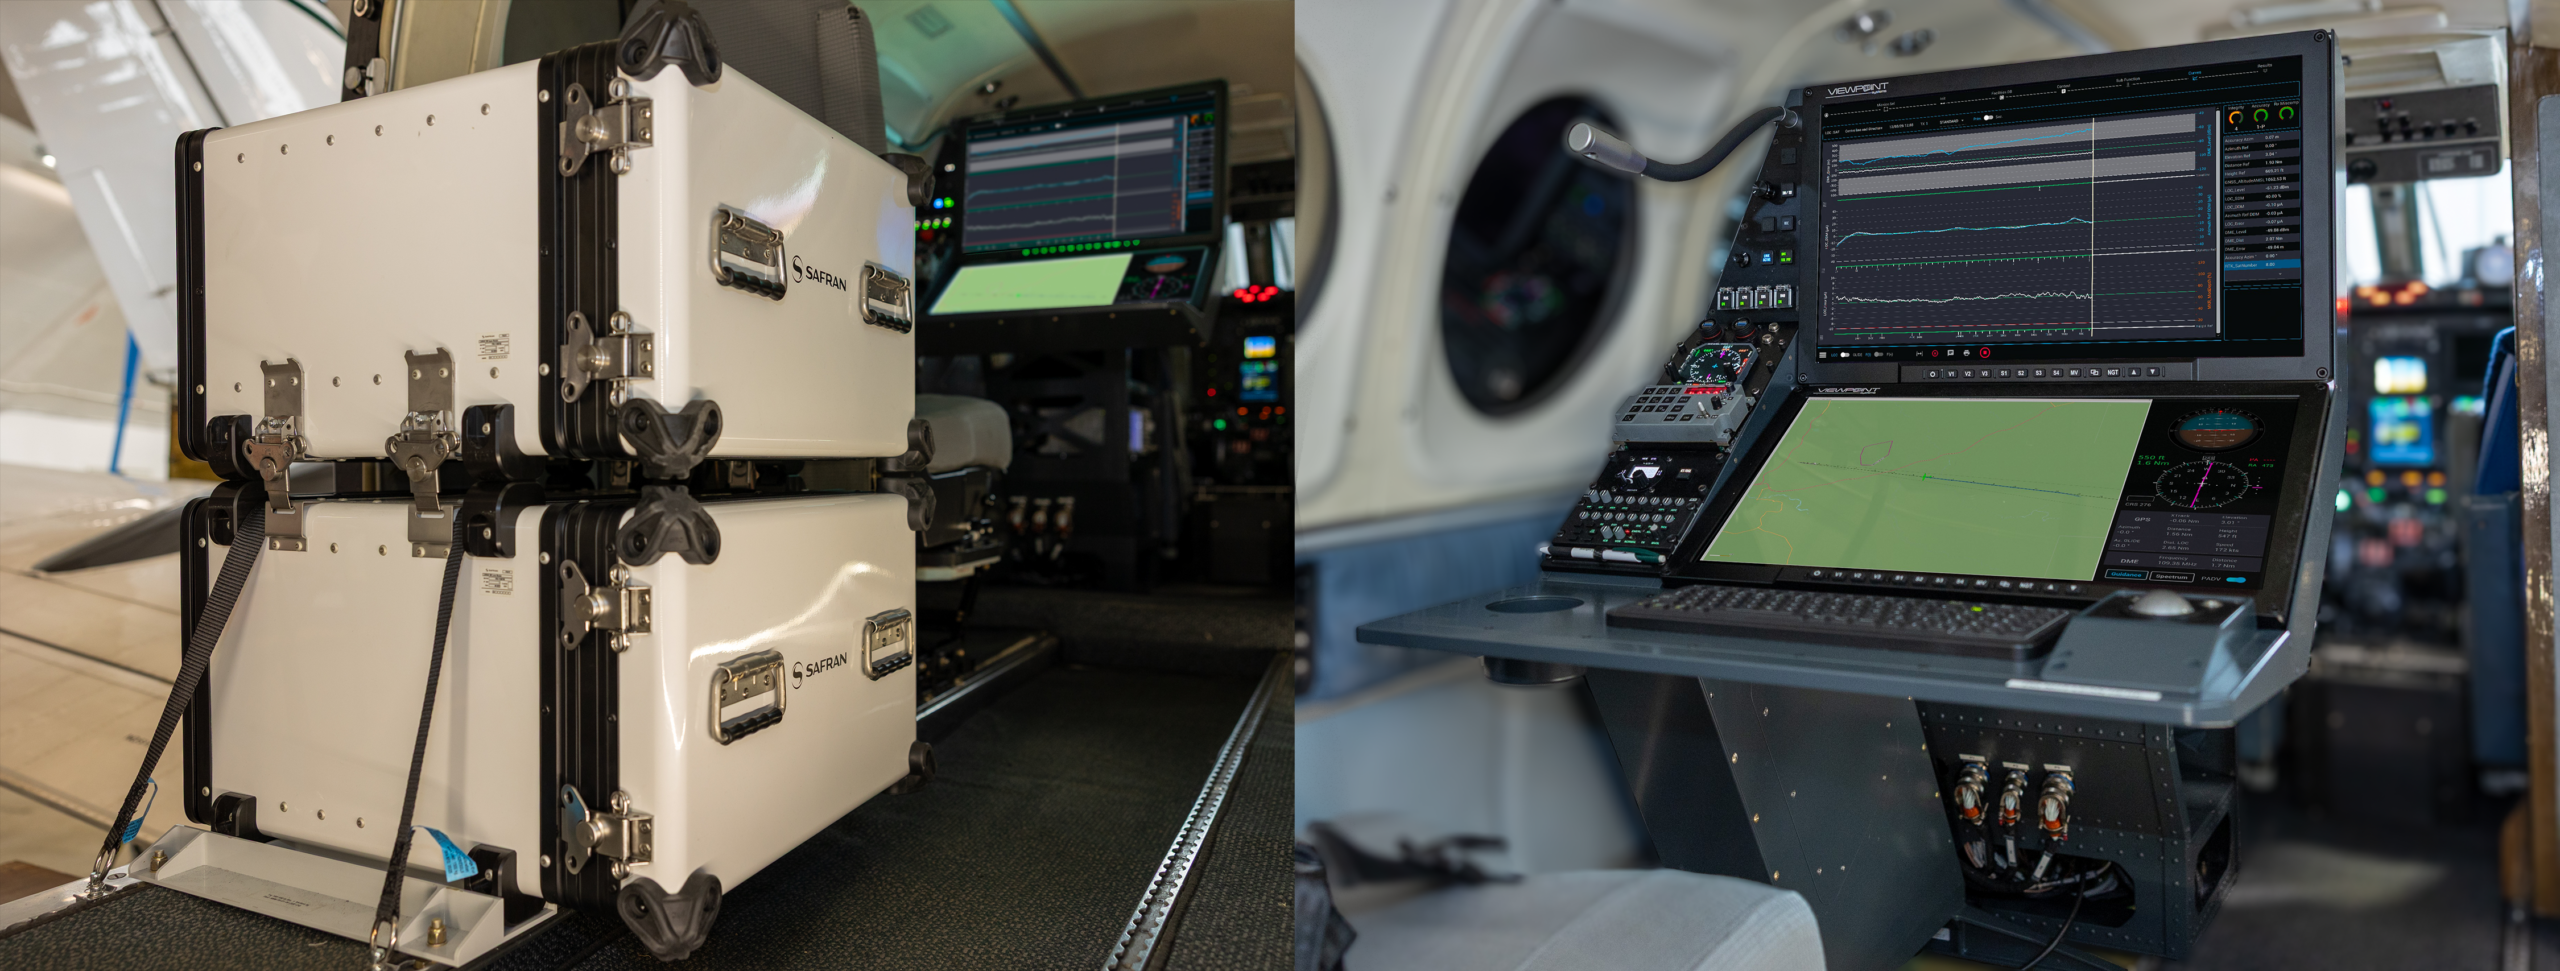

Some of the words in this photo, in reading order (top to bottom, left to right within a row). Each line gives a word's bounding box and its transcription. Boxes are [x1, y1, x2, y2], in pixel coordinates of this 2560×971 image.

[1827, 82, 1889, 95] VIEWPOINT
[805, 266, 847, 292] SAFRAN
[805, 652, 847, 678] SAFRAN
